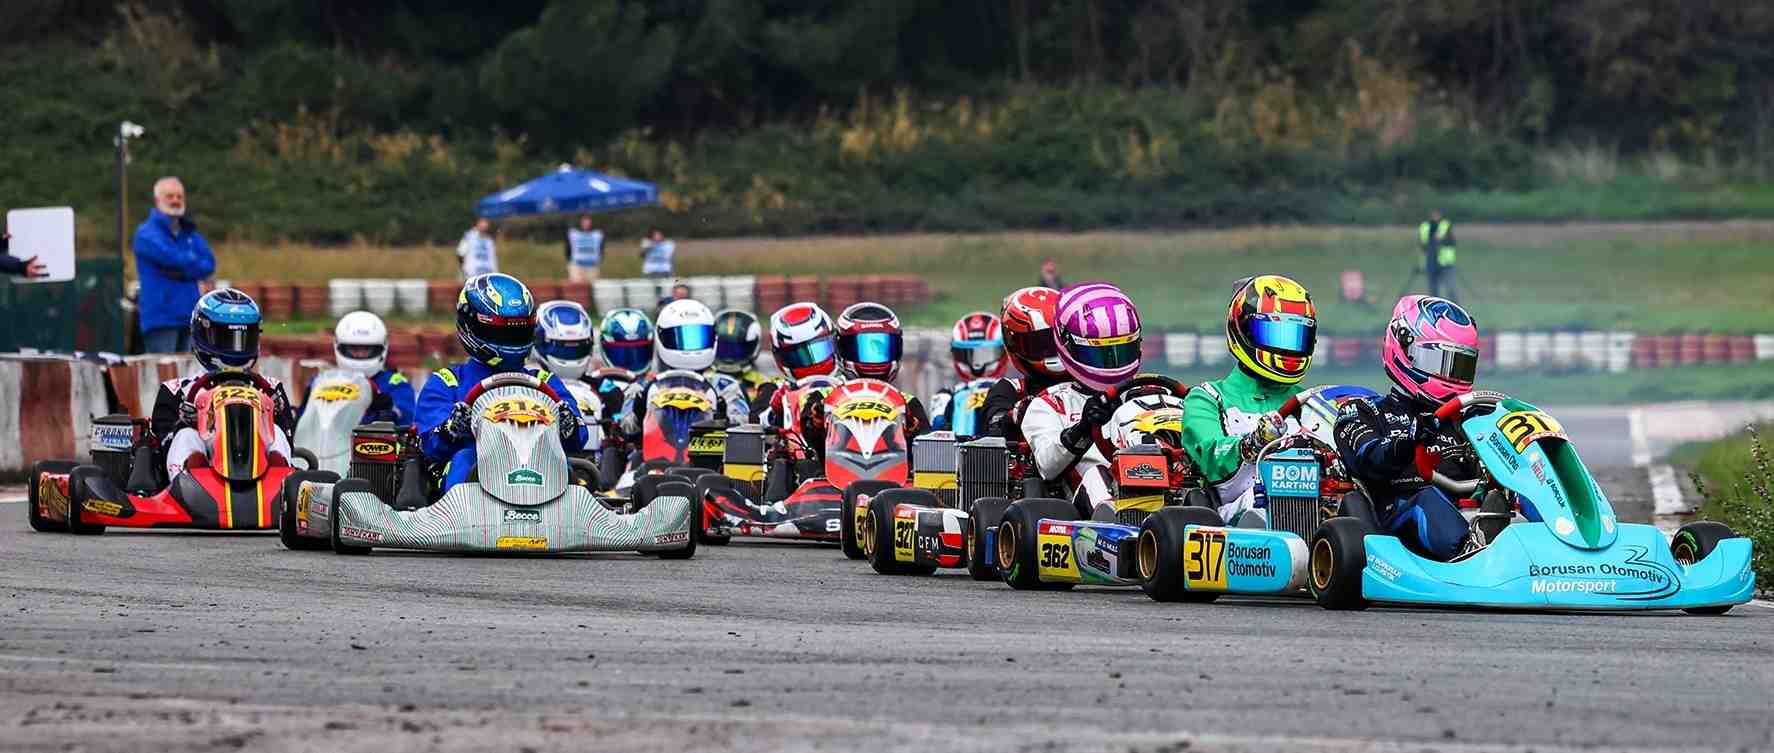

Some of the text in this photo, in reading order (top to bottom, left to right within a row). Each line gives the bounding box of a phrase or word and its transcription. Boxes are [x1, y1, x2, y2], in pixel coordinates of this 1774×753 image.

[1499, 413, 1552, 447] 31
[1272, 464, 1317, 481] BOM
[1272, 480, 1316, 490] KARTING
[1041, 543, 1070, 568] 362
[1188, 532, 1226, 581] 317
[1228, 543, 1271, 560] Borusan
[1228, 559, 1276, 577] Otomotiv
[1529, 563, 1663, 583] Borusan Otomotiv
[1531, 579, 1616, 593] Motorsport
